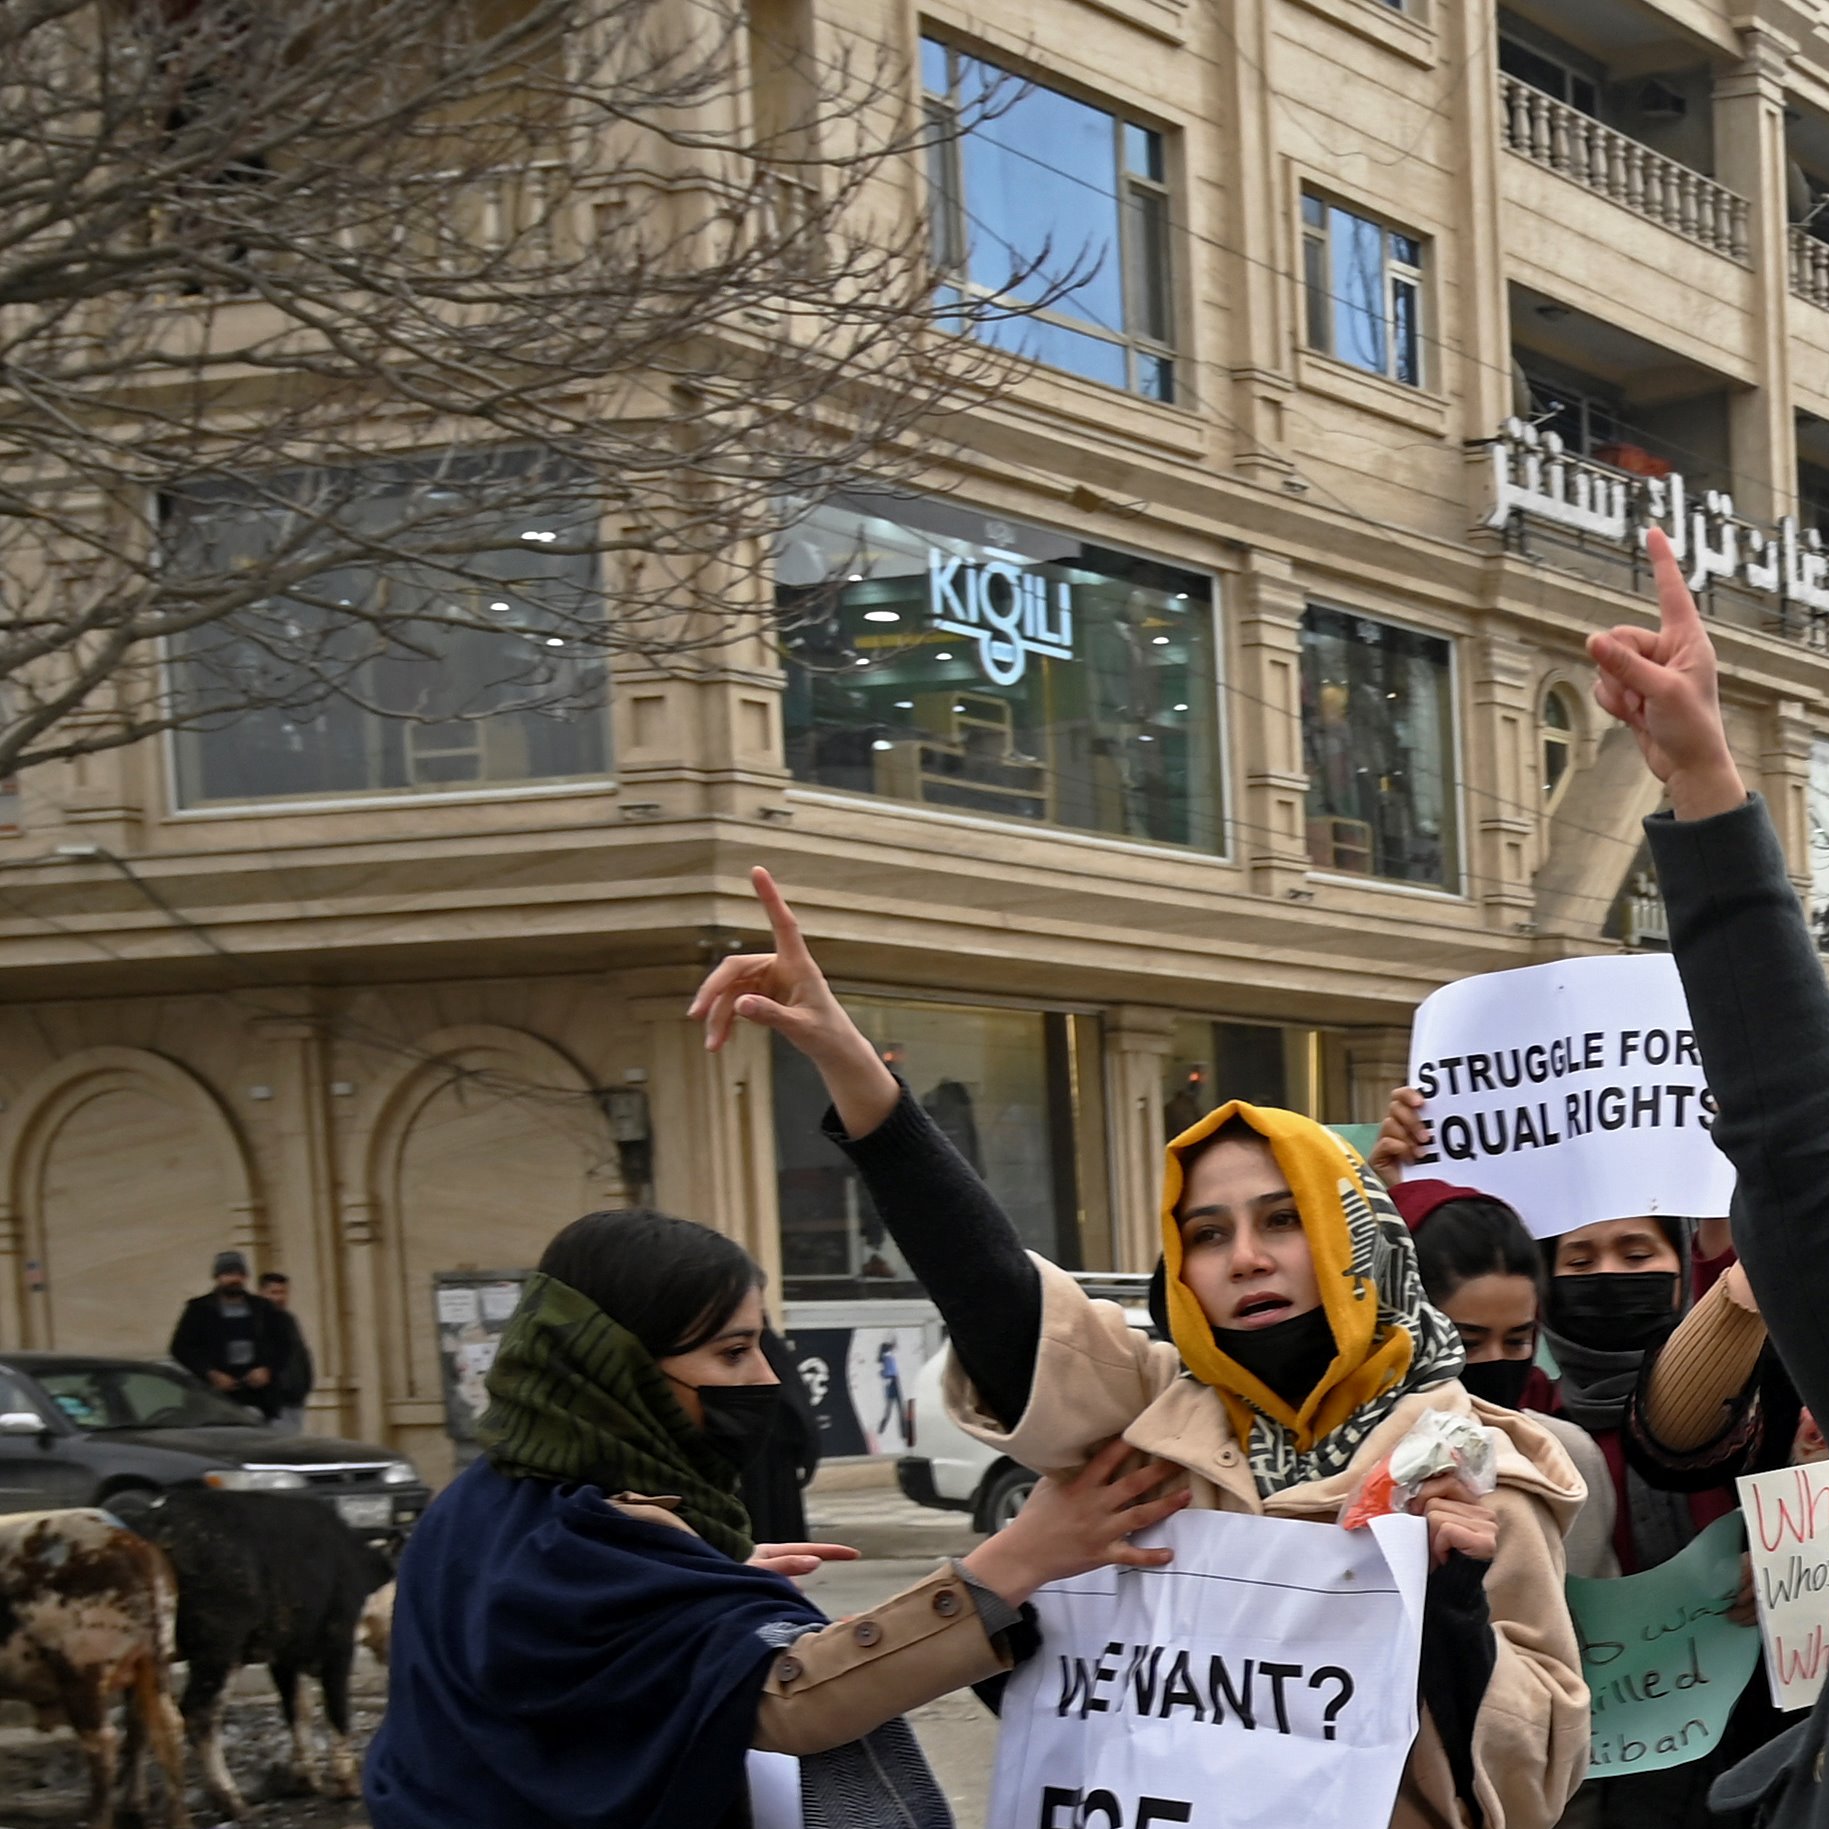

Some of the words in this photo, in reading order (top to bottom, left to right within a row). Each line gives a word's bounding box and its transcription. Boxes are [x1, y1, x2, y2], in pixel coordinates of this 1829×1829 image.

[1418, 1031, 1604, 1099] STRUGGLE
[1620, 1028, 1703, 1067] FOR
[1590, 1637, 1710, 1715] illed
